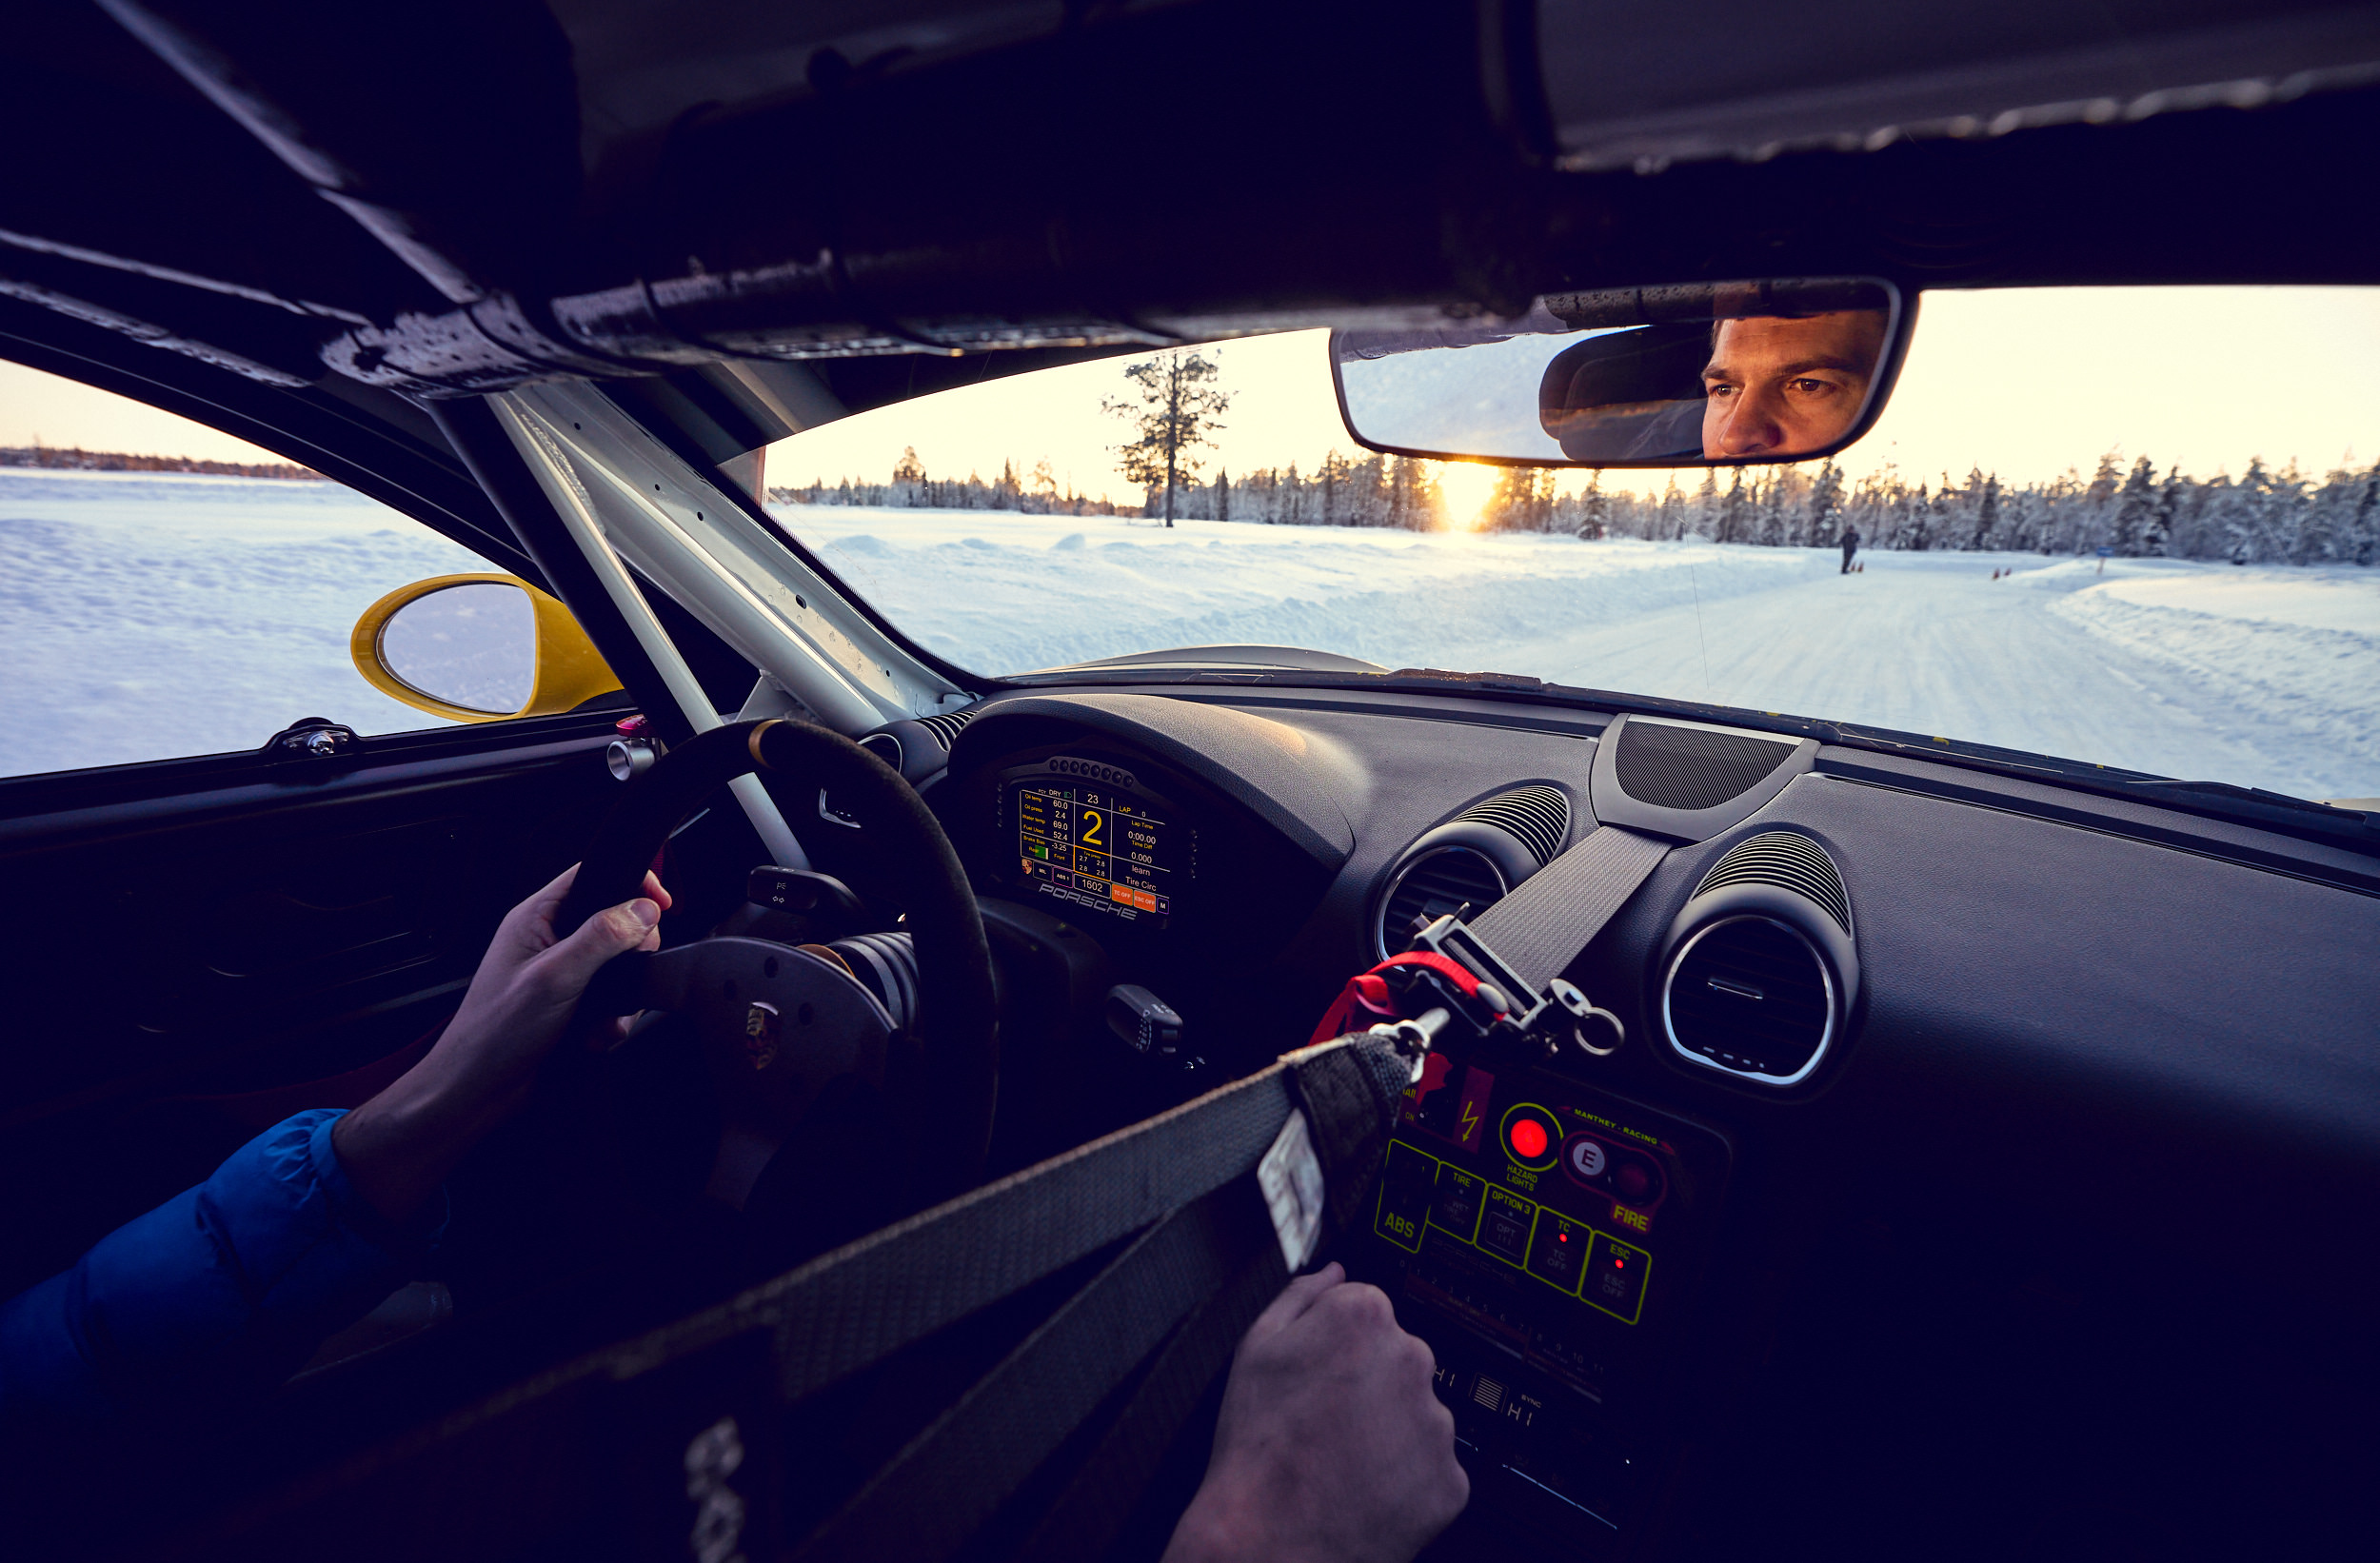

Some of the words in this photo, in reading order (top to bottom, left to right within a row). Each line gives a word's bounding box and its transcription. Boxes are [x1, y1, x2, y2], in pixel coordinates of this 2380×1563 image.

[1032, 795, 1042, 803] temp
[1053, 800, 1068, 810] 60.0
[1087, 793, 1099, 804] 23
[1055, 810, 1065, 819] 2.4
[1053, 821, 1068, 830] 69.0
[1082, 810, 1102, 845] 2
[1053, 831, 1067, 841] 52.4
[1127, 830, 1157, 845] 0:00.00
[1051, 842, 1066, 852] -3.25
[1131, 851, 1153, 863] 0.000
[1096, 869, 1105, 878] 2.8
[1131, 864, 1151, 877] learn
[1081, 879, 1103, 893] 1602
[1125, 876, 1140, 887] Tire
[1140, 880, 1157, 892] Circ
[1038, 882, 1138, 920] PORSCHE
[1574, 1108, 1616, 1129] MANTHEY
[1622, 1126, 1658, 1145] RACING
[1581, 1149, 1597, 1169] E
[1453, 1172, 1472, 1188] TIRE
[1506, 1163, 1538, 1184] HAZARD
[1506, 1173, 1535, 1192] LIGHTS
[1492, 1190, 1523, 1212] OPTION
[1523, 1204, 1531, 1216] 3
[1384, 1211, 1415, 1238] ABS
[1557, 1218, 1571, 1233] TC
[1613, 1203, 1650, 1233] FIRE
[1496, 1222, 1517, 1237] OPT
[1553, 1248, 1566, 1262] TC
[1609, 1243, 1631, 1261] ESC
[1546, 1256, 1568, 1272] OFF
[1603, 1273, 1626, 1291] ESC
[1601, 1283, 1624, 1298] OFF
[1520, 1394, 1542, 1409] SYNC
[1507, 1402, 1533, 1427] HI
